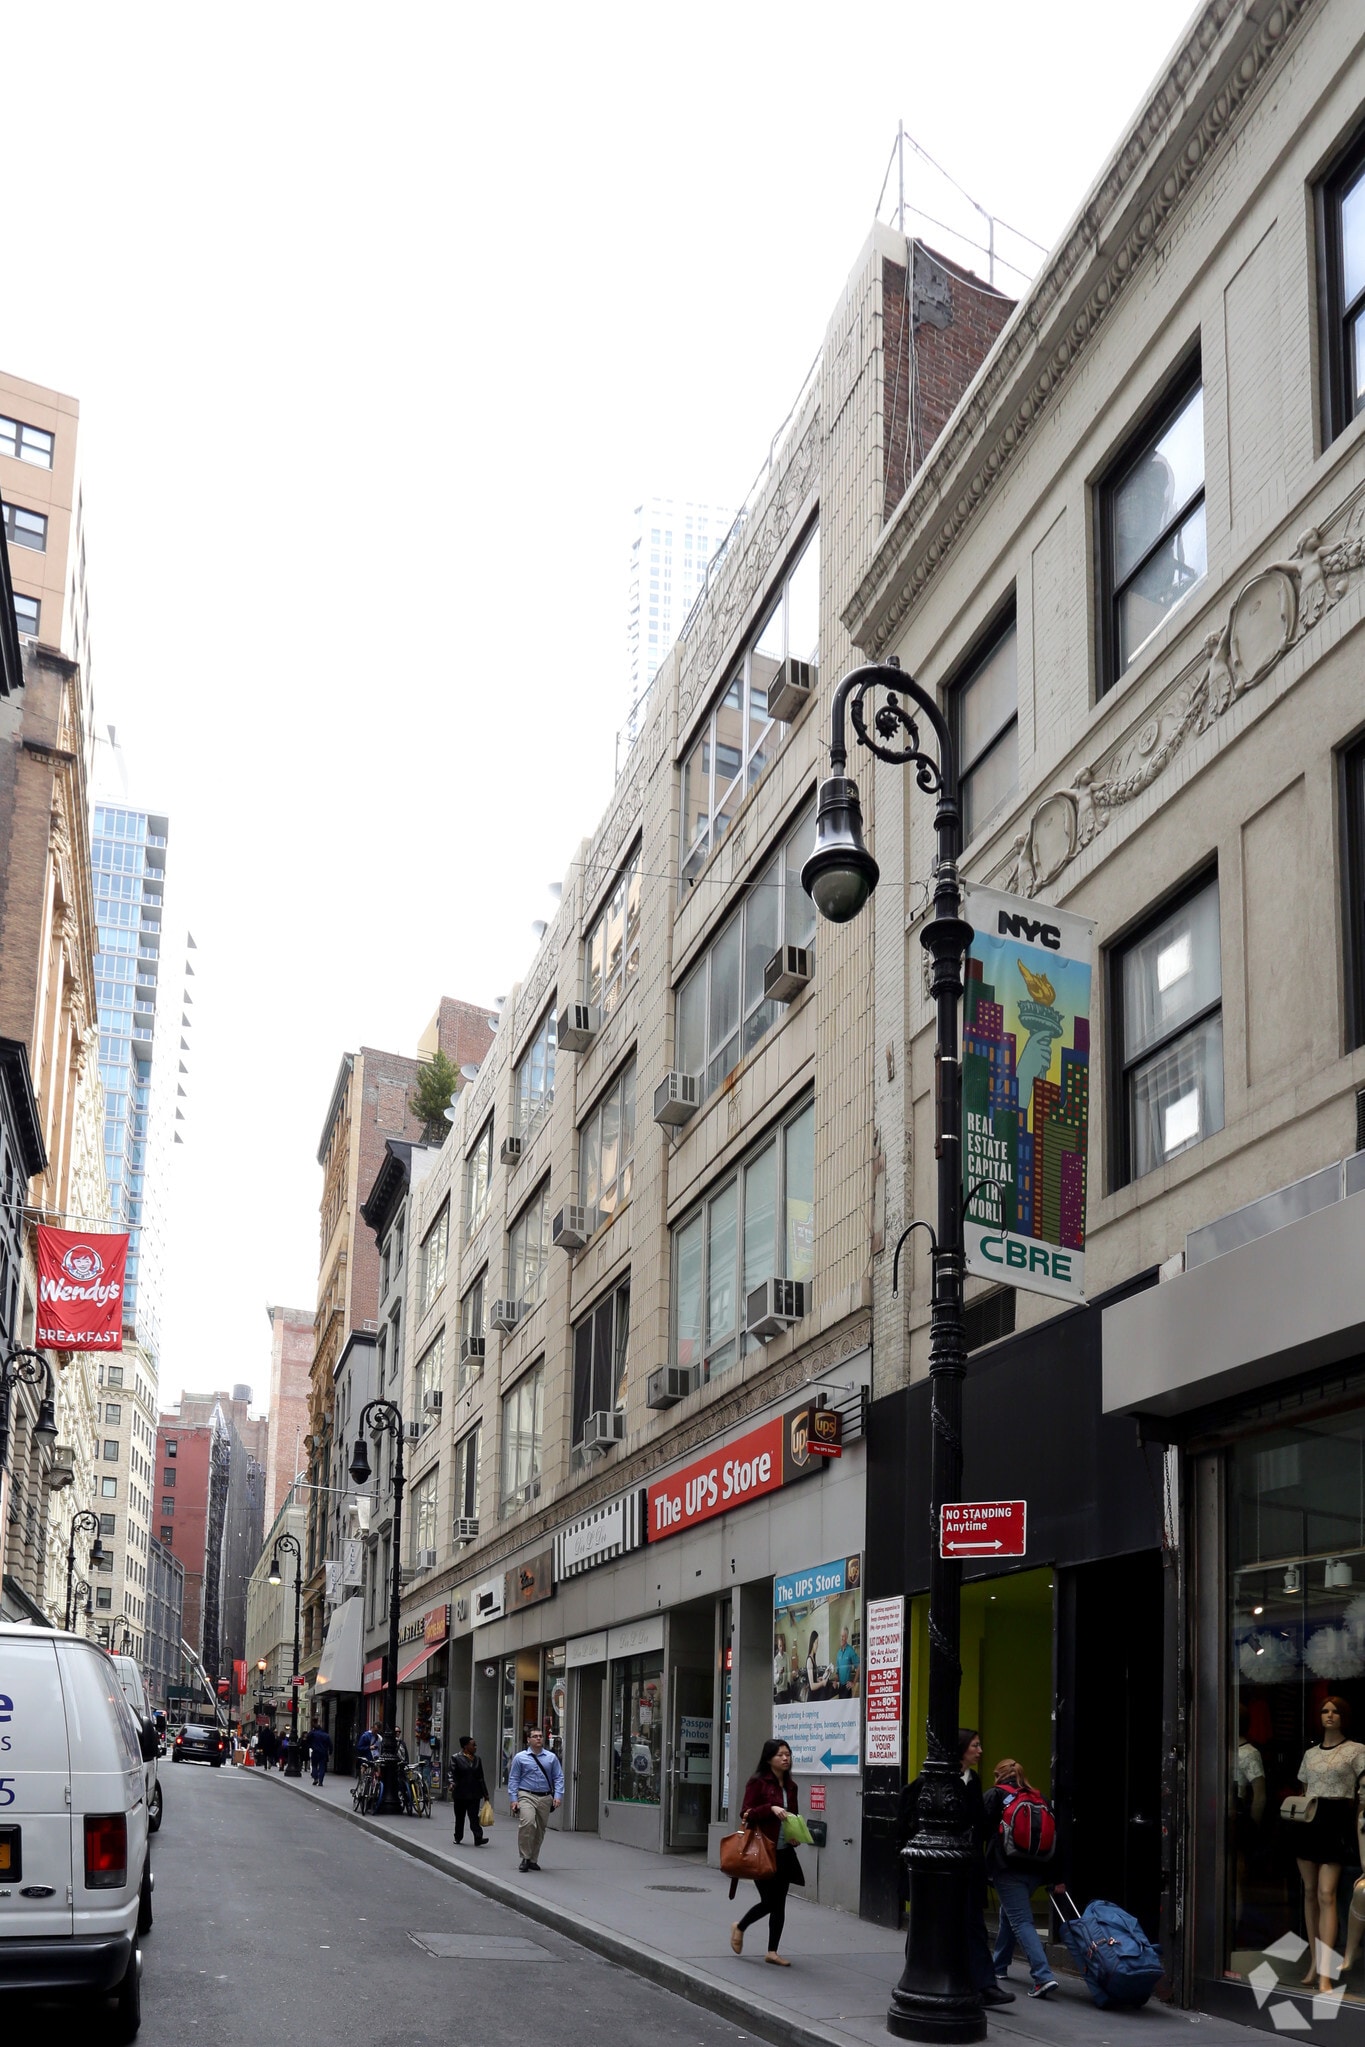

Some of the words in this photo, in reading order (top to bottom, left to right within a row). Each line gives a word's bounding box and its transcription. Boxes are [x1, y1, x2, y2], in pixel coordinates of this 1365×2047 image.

[998, 910, 1061, 951] NYC
[967, 1112, 994, 1137] REAL
[967, 1133, 1008, 1161] ESTATE
[967, 1154, 1014, 1183] CAPITAL
[985, 1179, 1006, 1203] TH
[980, 1236, 1072, 1282] CBRE
[40, 1275, 120, 1307] Wendy's
[38, 1327, 119, 1342] BREAKFAST
[817, 1420, 835, 1436] ups
[655, 1493, 681, 1530] The
[685, 1468, 718, 1517] UPS
[722, 1452, 771, 1500] Store
[946, 1510, 960, 1520] NO
[962, 1507, 1012, 1519] STANDING
[946, 1521, 987, 1533] Anytime
[778, 1585, 793, 1602] The
[795, 1577, 813, 1598] UPS
[815, 1574, 841, 1593] Store
[882, 1670, 897, 1680] 50%
[882, 1697, 897, 1706] 80%
[680, 1727, 709, 1739] Photos
[871, 1734, 895, 1742] DISCOVER
[875, 1742, 891, 1750] YOUR
